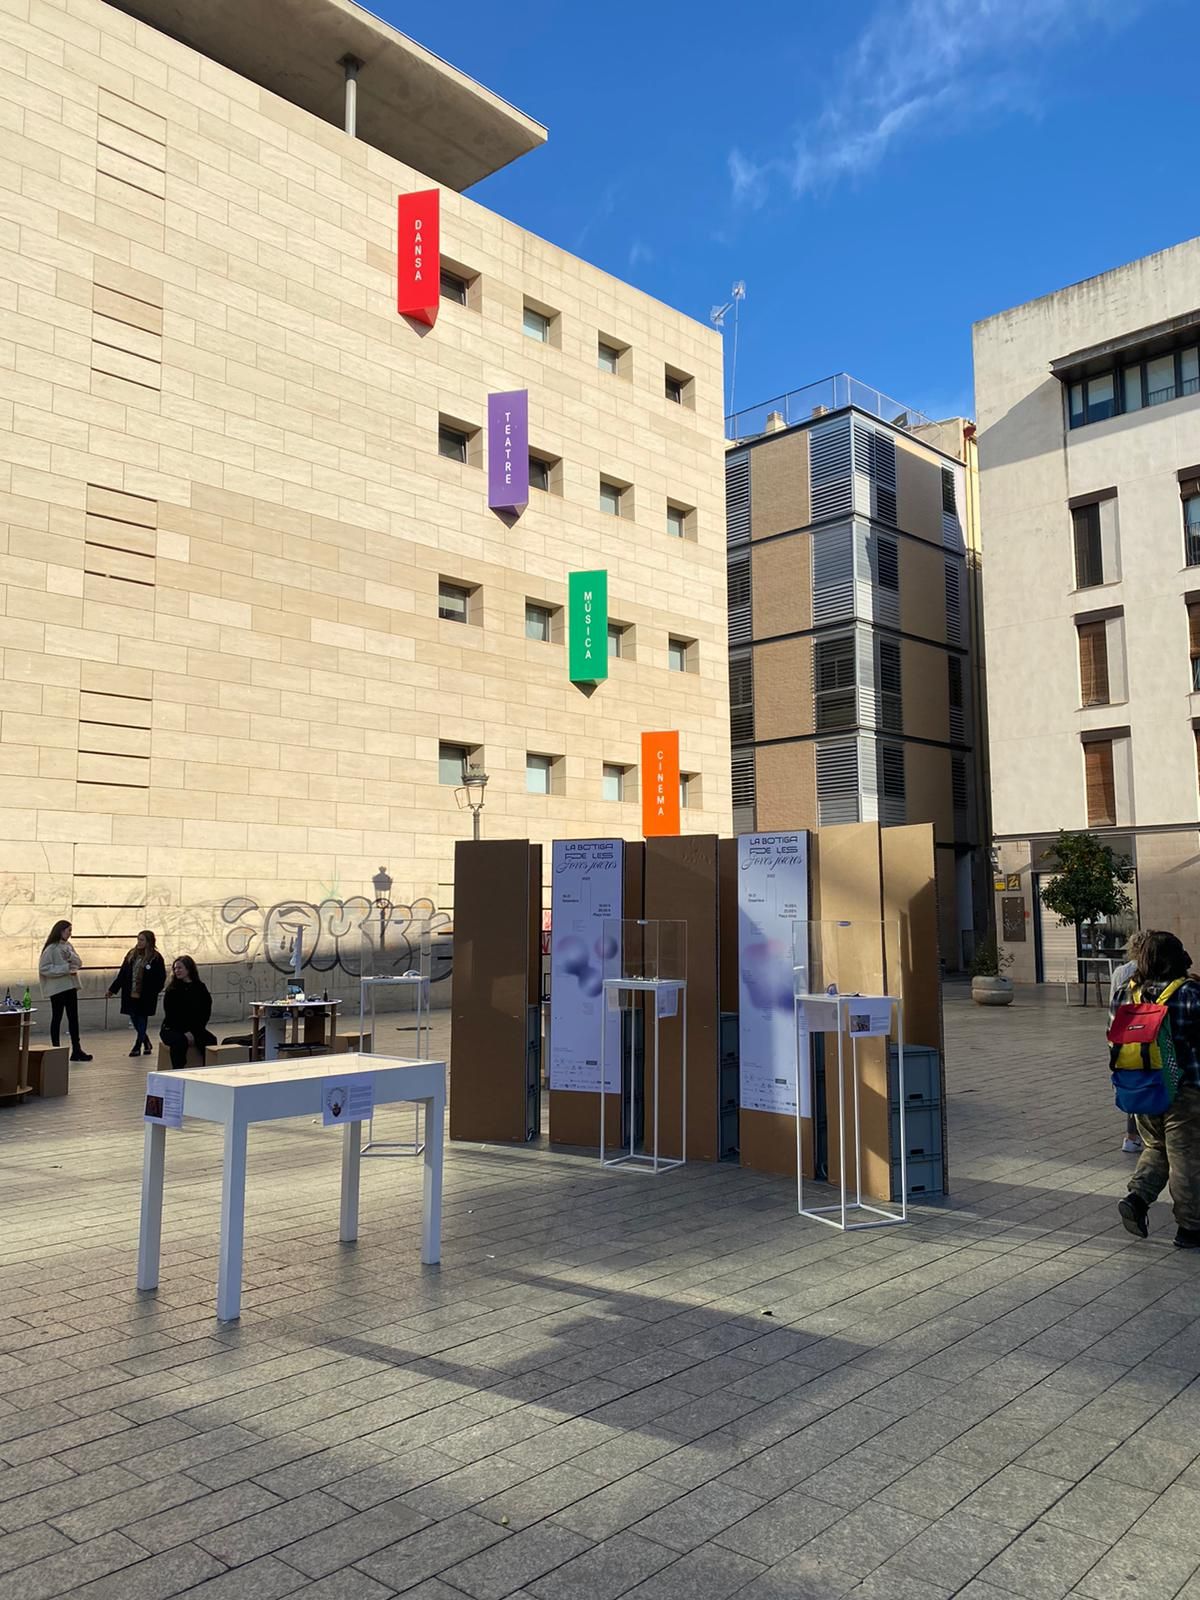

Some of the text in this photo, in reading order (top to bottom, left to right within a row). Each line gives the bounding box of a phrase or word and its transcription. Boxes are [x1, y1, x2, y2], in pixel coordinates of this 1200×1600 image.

[414, 219, 422, 281] DANSA
[504, 411, 512, 484] TEATRE
[583, 591, 593, 659] MÚSICA
[656, 750, 665, 816] CINEMA
[577, 843, 614, 851] BOTIGA
[592, 852, 614, 860] LES
[762, 836, 798, 844] BOTIGA
[776, 846, 798, 854] LES
